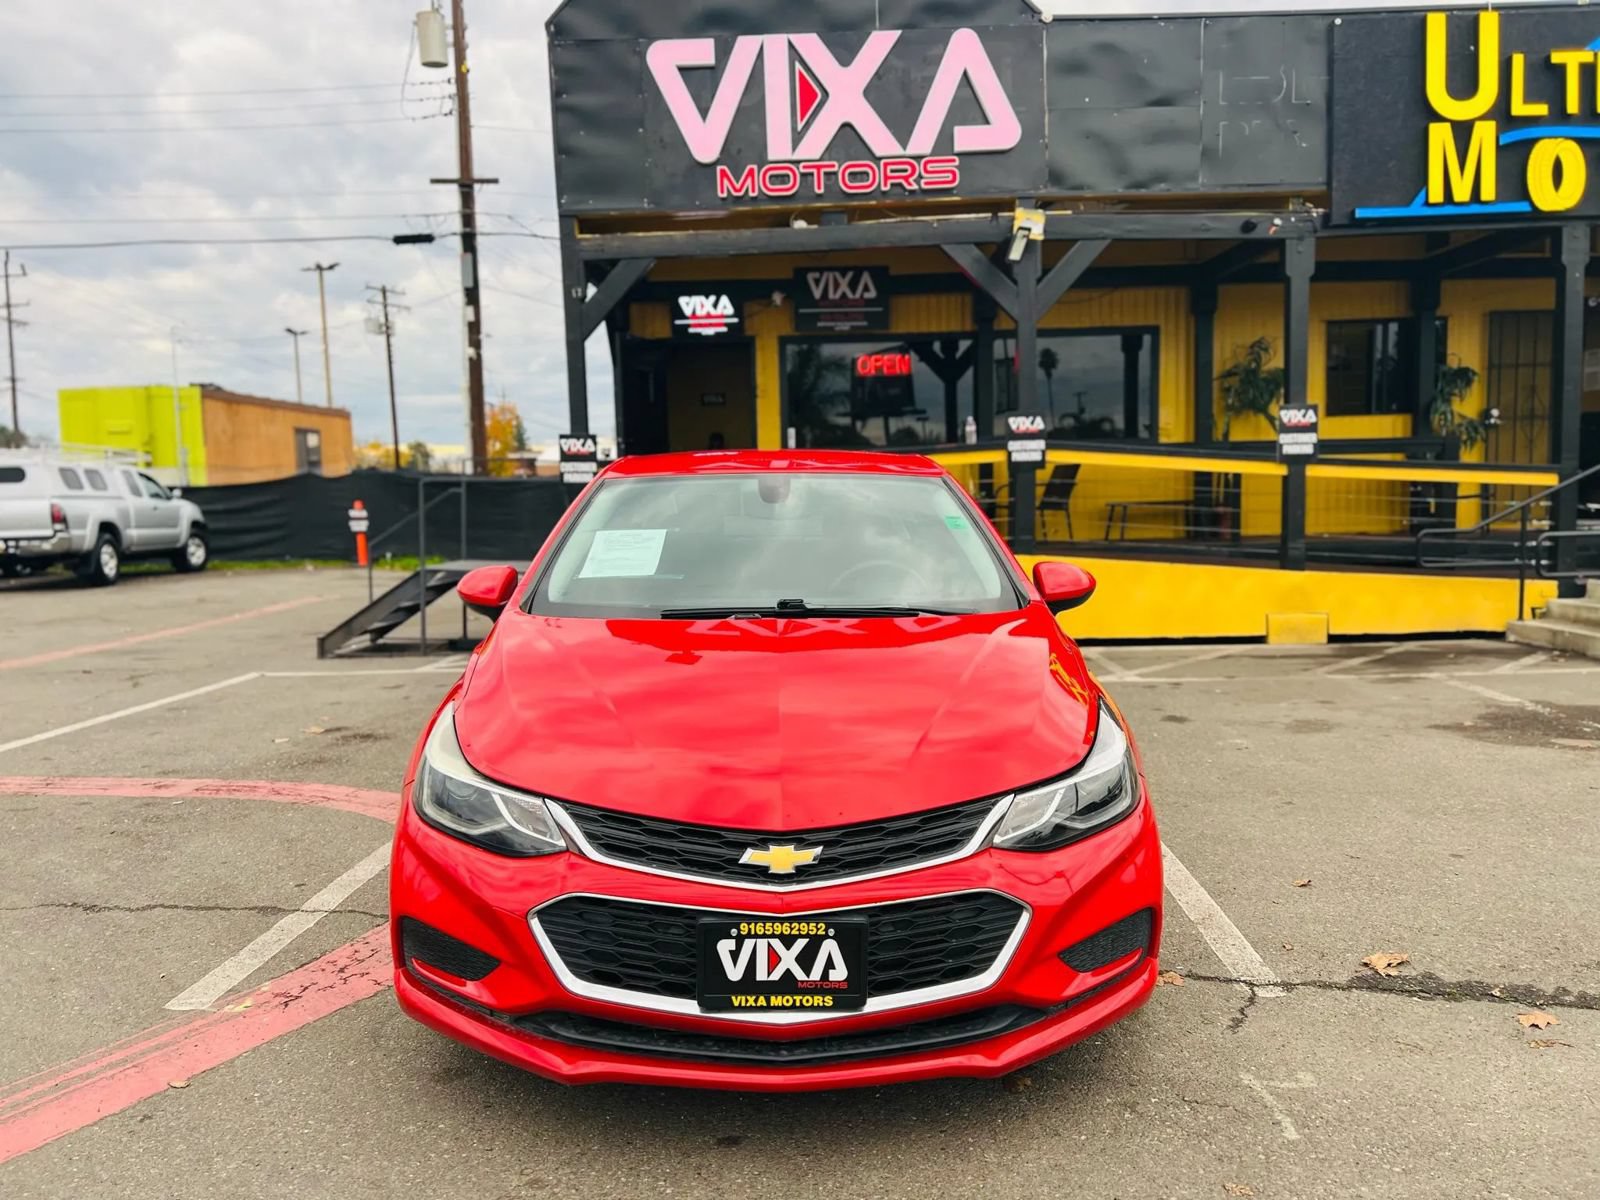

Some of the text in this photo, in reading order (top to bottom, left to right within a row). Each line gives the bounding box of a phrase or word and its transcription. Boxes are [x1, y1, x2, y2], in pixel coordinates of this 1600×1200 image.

[1425, 10, 1600, 121] ULT
[645, 28, 1022, 164] VIXA
[716, 156, 960, 198] MOTORS
[806, 271, 877, 300] VIXA
[678, 294, 735, 317] VIXA
[857, 353, 912, 376] OPEN
[740, 923, 826, 935] 9165962952
[716, 938, 848, 982] VIXA
[731, 996, 833, 1007] VIXA MOTORS
